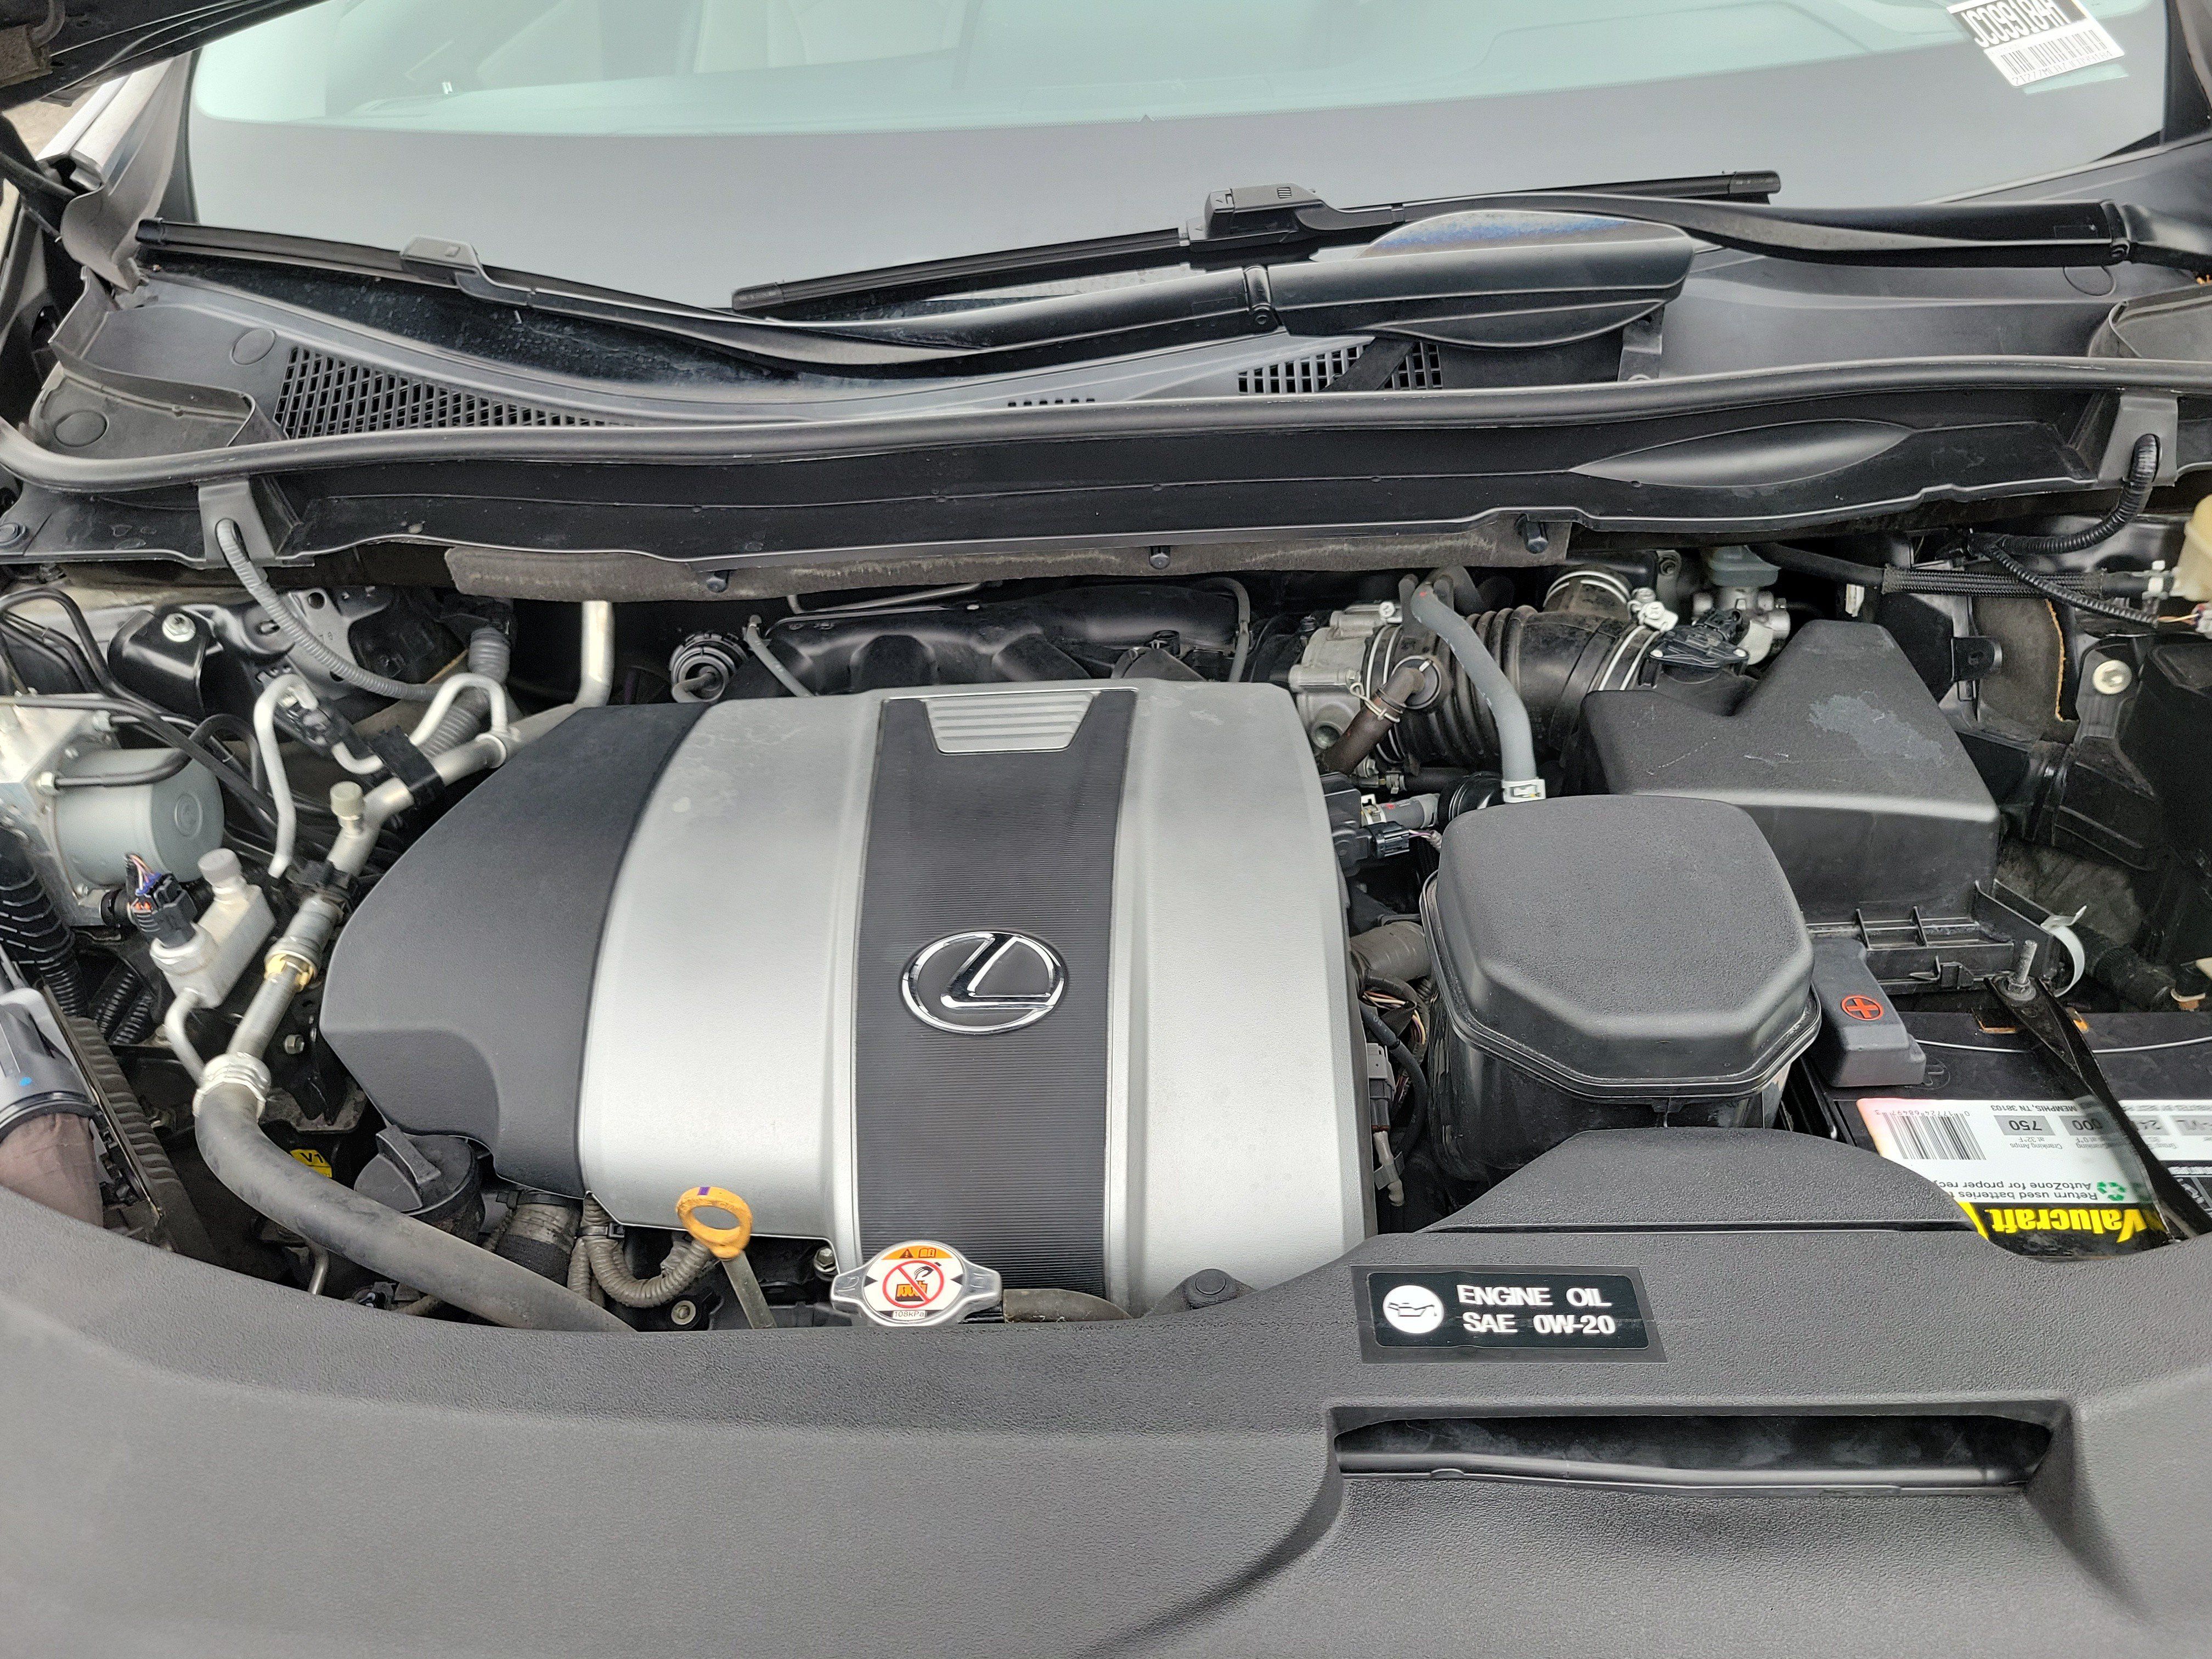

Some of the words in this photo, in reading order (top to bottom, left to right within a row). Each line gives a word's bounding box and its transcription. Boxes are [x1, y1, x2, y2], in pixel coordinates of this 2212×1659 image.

[2008, 1120, 2042, 1131] 750
[300, 1152, 324, 1164] V1
[1962, 1181, 2004, 1189] proper
[2008, 1182, 2026, 1190] for
[2030, 1182, 2091, 1190] AutoZone
[1958, 1192, 2015, 1200] batteries
[2054, 1192, 2098, 1200] Return
[1457, 1284, 1553, 1306] ENGINE
[1566, 1288, 1612, 1306] OIL
[1462, 1312, 1518, 1333] SAE
[1533, 1314, 1616, 1334] 0W-20
